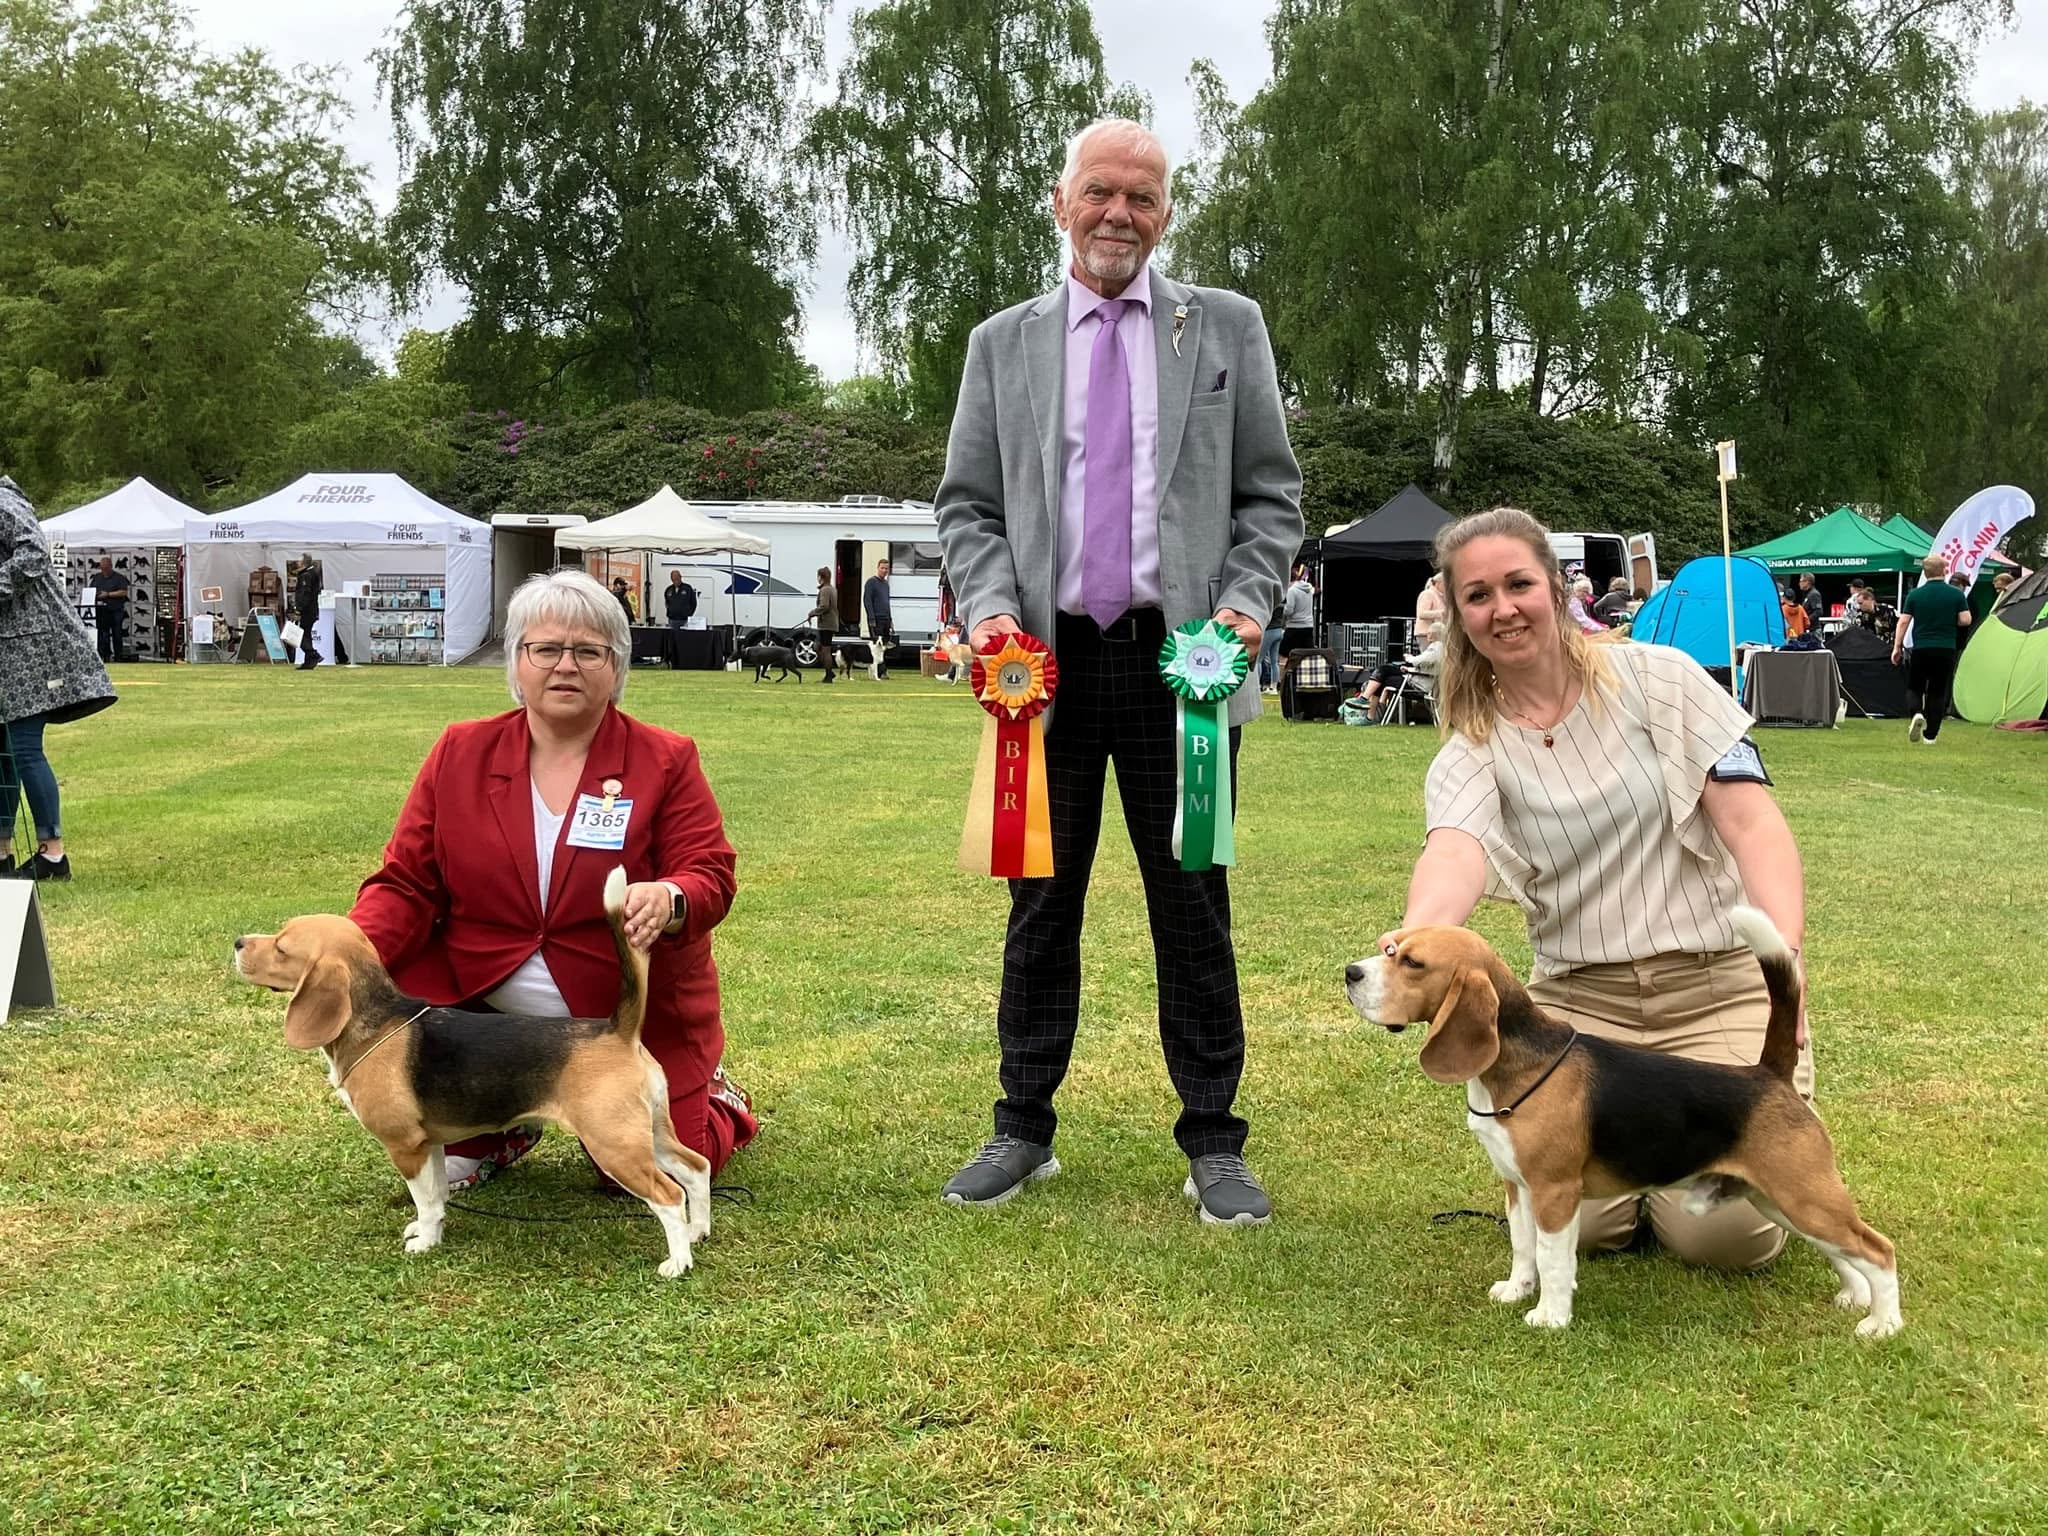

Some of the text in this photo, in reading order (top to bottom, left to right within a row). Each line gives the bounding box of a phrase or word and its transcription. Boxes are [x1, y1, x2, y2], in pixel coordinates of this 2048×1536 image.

[317, 485, 368, 495] FOUR
[297, 494, 376, 504] FRIENDS
[215, 522, 239, 530] FOUR
[393, 524, 417, 532] FOUR
[209, 530, 245, 538] FRIENDS
[387, 532, 423, 540] FRIENDS
[1964, 521, 1999, 569] CANIN
[1766, 557, 1868, 568] ENSKA KENNELKLUBBEN
[1003, 740, 1021, 811] BIR
[1189, 734, 1210, 814] BIM
[578, 811, 625, 828] 1365
